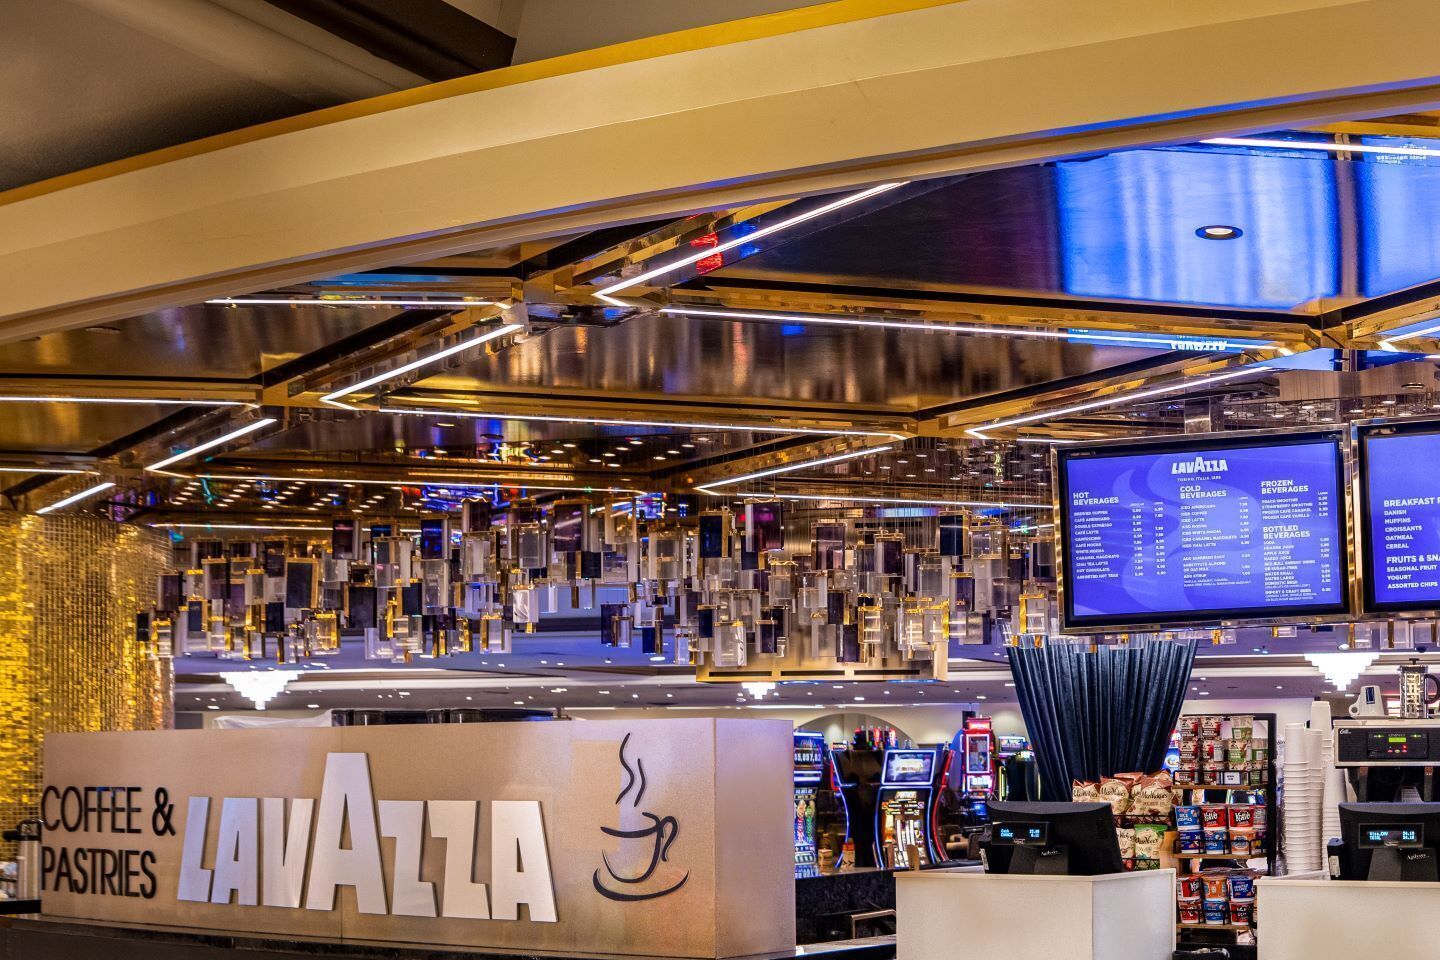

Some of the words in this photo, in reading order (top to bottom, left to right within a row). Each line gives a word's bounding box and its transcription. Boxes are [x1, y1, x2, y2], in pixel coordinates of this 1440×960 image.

[1172, 457, 1228, 475] LAVAZZA
[1261, 480, 1293, 488] FROZEN
[1262, 485, 1309, 495] BEVERAGES
[1181, 491, 1227, 499] BEVERAGES
[1074, 497, 1119, 506] BEVERAGES
[1384, 497, 1435, 507] BREAKFAST
[1263, 525, 1299, 533] BOTTLED
[1264, 531, 1311, 540] BEVERAGES
[1386, 556, 1417, 564] FRUITS
[41, 785, 142, 835] COFFEE
[151, 787, 176, 836] &
[176, 752, 558, 922] LAVAZZA
[41, 848, 157, 899] PASTRIES
